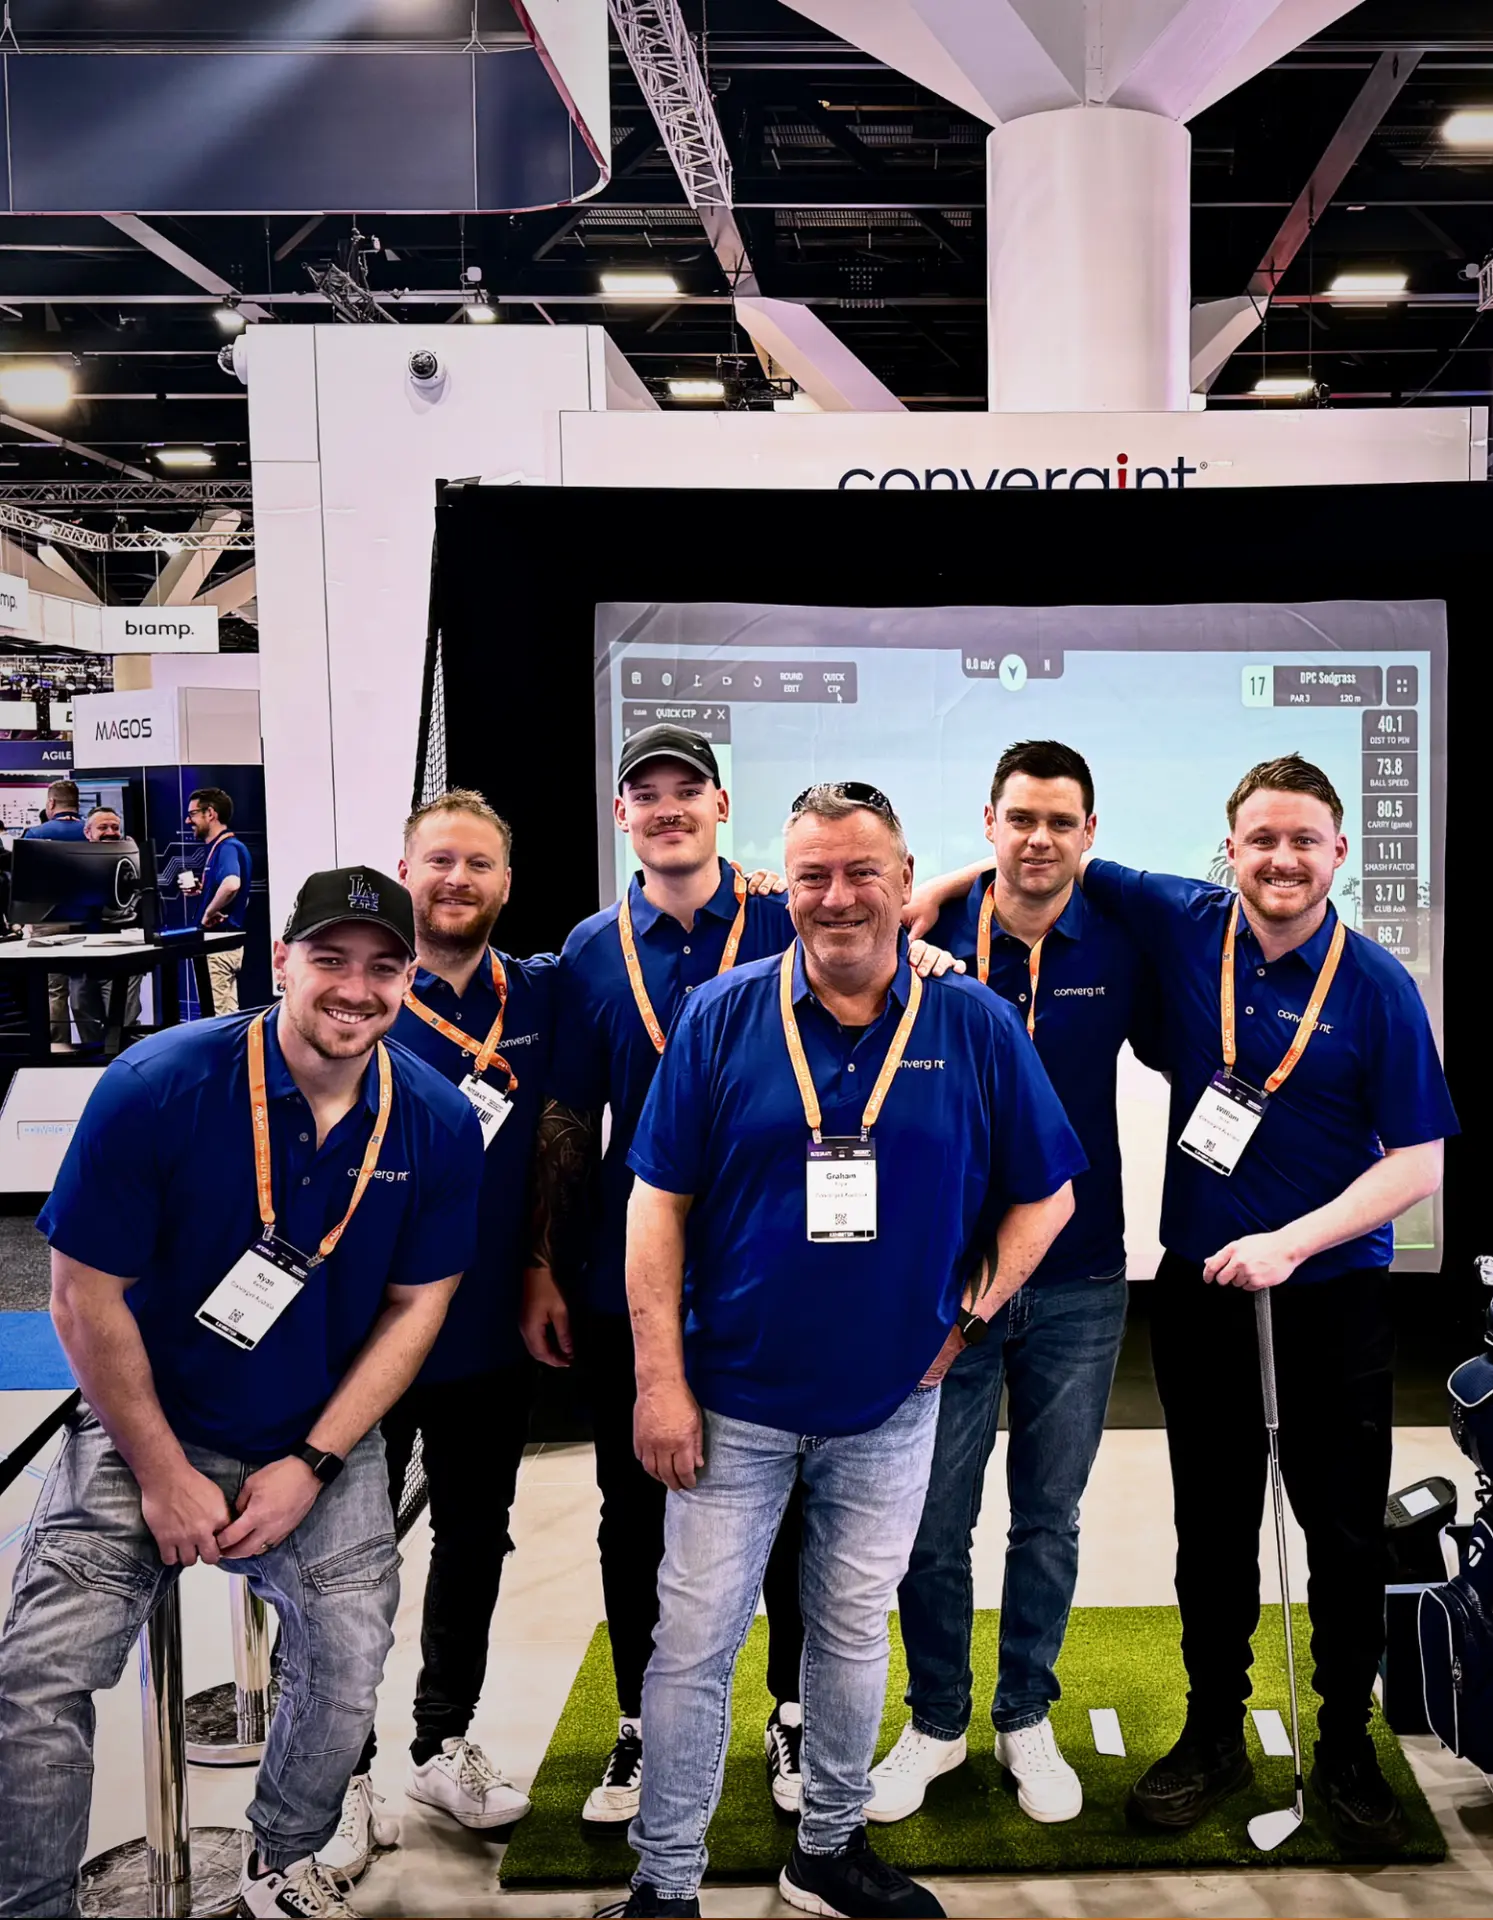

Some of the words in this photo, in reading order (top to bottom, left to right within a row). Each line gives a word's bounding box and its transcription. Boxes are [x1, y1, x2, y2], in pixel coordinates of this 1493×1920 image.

[1250, 677, 1266, 696] 17
[1290, 695, 1304, 703] PAR
[1305, 695, 1311, 703] 3
[1340, 694, 1353, 703] 120
[656, 708, 680, 719] QUICK
[682, 709, 697, 719] CTP
[95, 718, 152, 741] MAGOS
[1378, 715, 1403, 733] 40.1
[1370, 736, 1385, 744] DIST
[1387, 736, 1396, 744] TO
[42, 751, 72, 760] AGILE
[1377, 758, 1403, 775] 73.8
[1370, 779, 1386, 787] BALL
[1388, 779, 1409, 787] SPEED
[1377, 800, 1403, 818] 80.5
[1367, 821, 1389, 829] CARRY
[1379, 842, 1402, 860] 1.11
[1365, 863, 1387, 871] SMASH
[1389, 863, 1415, 871] FACTOR
[348, 875, 379, 911] LA
[1375, 884, 1393, 902] 3.7
[1374, 905, 1391, 913] CLUB
[1378, 926, 1402, 943] 66.7
[826, 1172, 857, 1180] Graham
[256, 1273, 275, 1287] Ryan
